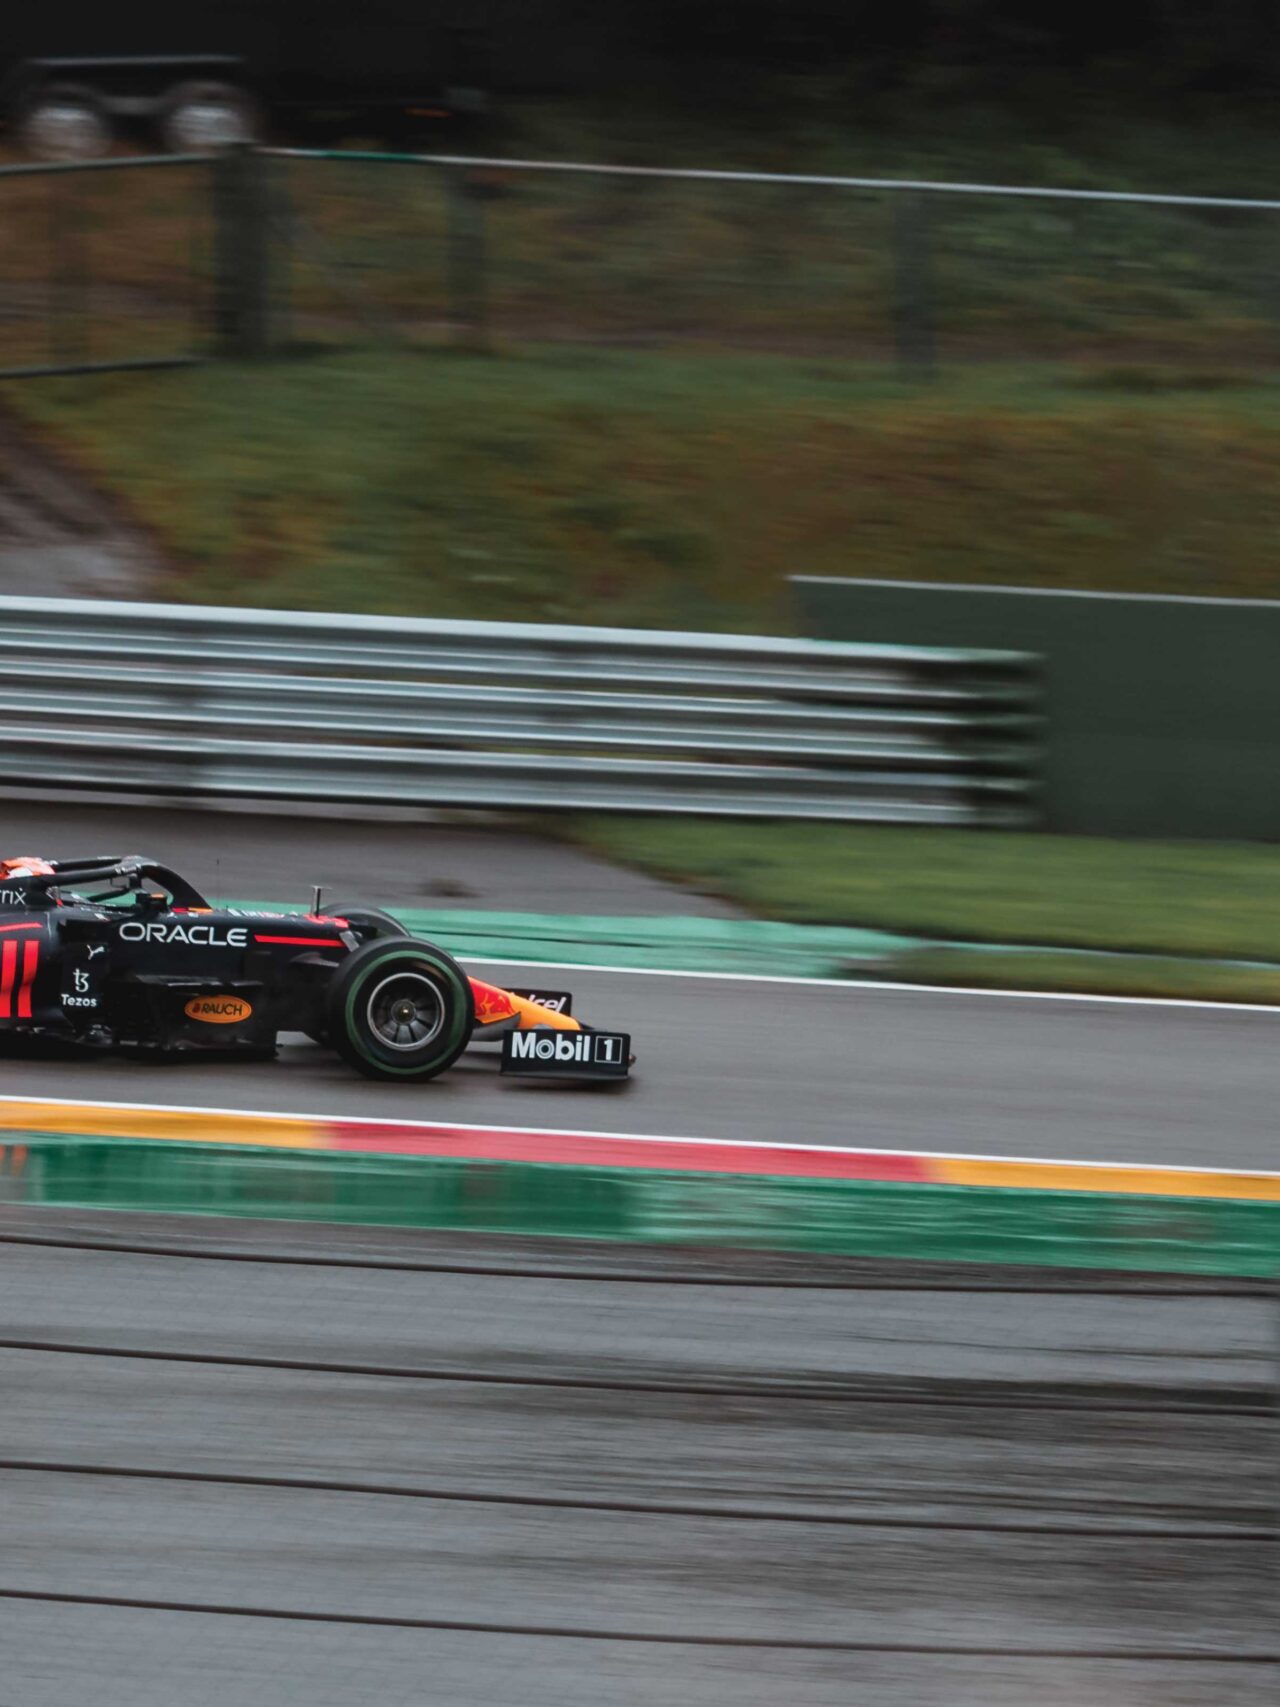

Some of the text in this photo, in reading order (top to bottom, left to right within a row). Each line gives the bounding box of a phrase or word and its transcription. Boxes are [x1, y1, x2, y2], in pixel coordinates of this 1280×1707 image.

[119, 922, 248, 947] ORACLE
[61, 993, 97, 1007] Tezos
[201, 1003, 243, 1016] RAUCH
[511, 1031, 591, 1062] Mobil
